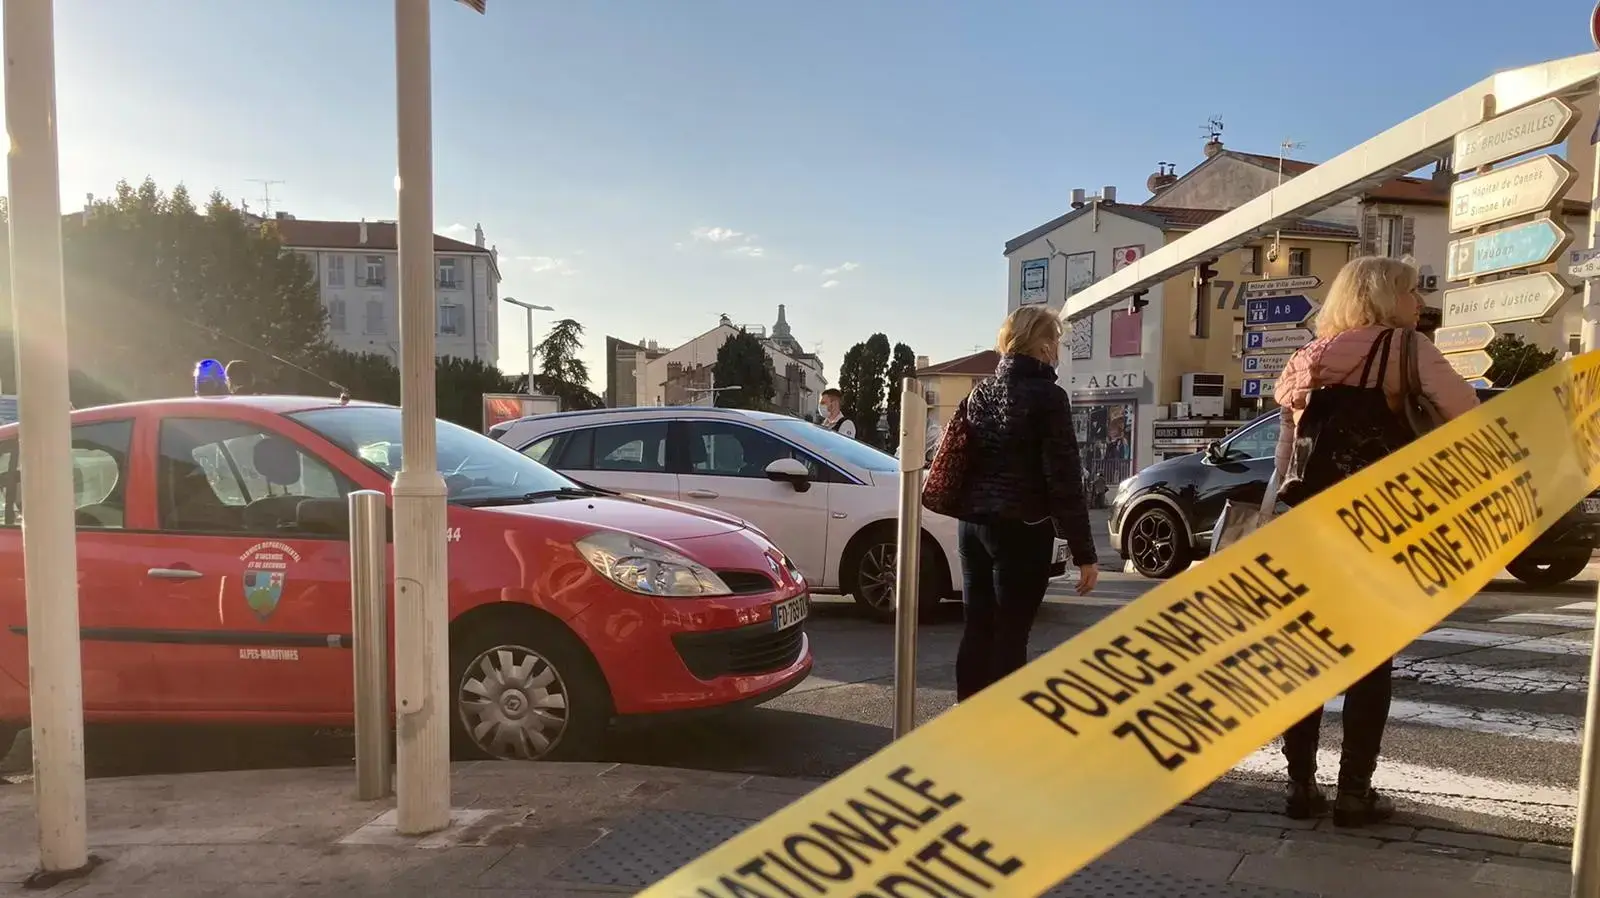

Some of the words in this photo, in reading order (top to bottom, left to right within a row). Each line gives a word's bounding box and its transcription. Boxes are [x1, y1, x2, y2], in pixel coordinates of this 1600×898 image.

[1460, 141, 1477, 157] LES
[1481, 114, 1556, 150] BROUSSAILLES
[1501, 178, 1511, 189] de
[1514, 170, 1543, 186] Cannes
[1470, 202, 1499, 217] Simone
[1502, 194, 1518, 208] Veil
[1477, 244, 1514, 260] Vauban
[1572, 264, 1583, 273] du
[1274, 305, 1281, 315] A
[1284, 304, 1291, 314] 8
[1449, 300, 1478, 316] Palais
[1483, 298, 1496, 310] de
[1501, 291, 1541, 307] Justice
[1251, 334, 1260, 346] P
[1248, 358, 1256, 368] P
[1088, 373, 1137, 388] ART
[1249, 382, 1257, 393] P
[1335, 471, 1440, 553] POLICE
[1412, 416, 1531, 504] NATIONALE
[1392, 523, 1476, 597] ZONE
[1452, 470, 1543, 562] INTERDITE
[1019, 634, 1177, 736] POLICE
[1135, 552, 1310, 662] NATIONALE
[239, 648, 299, 660] ALPES-MARITIMES
[1111, 682, 1241, 771] ZONE
[1197, 610, 1355, 718] INTERDITE
[694, 765, 964, 898] ATIONALE
